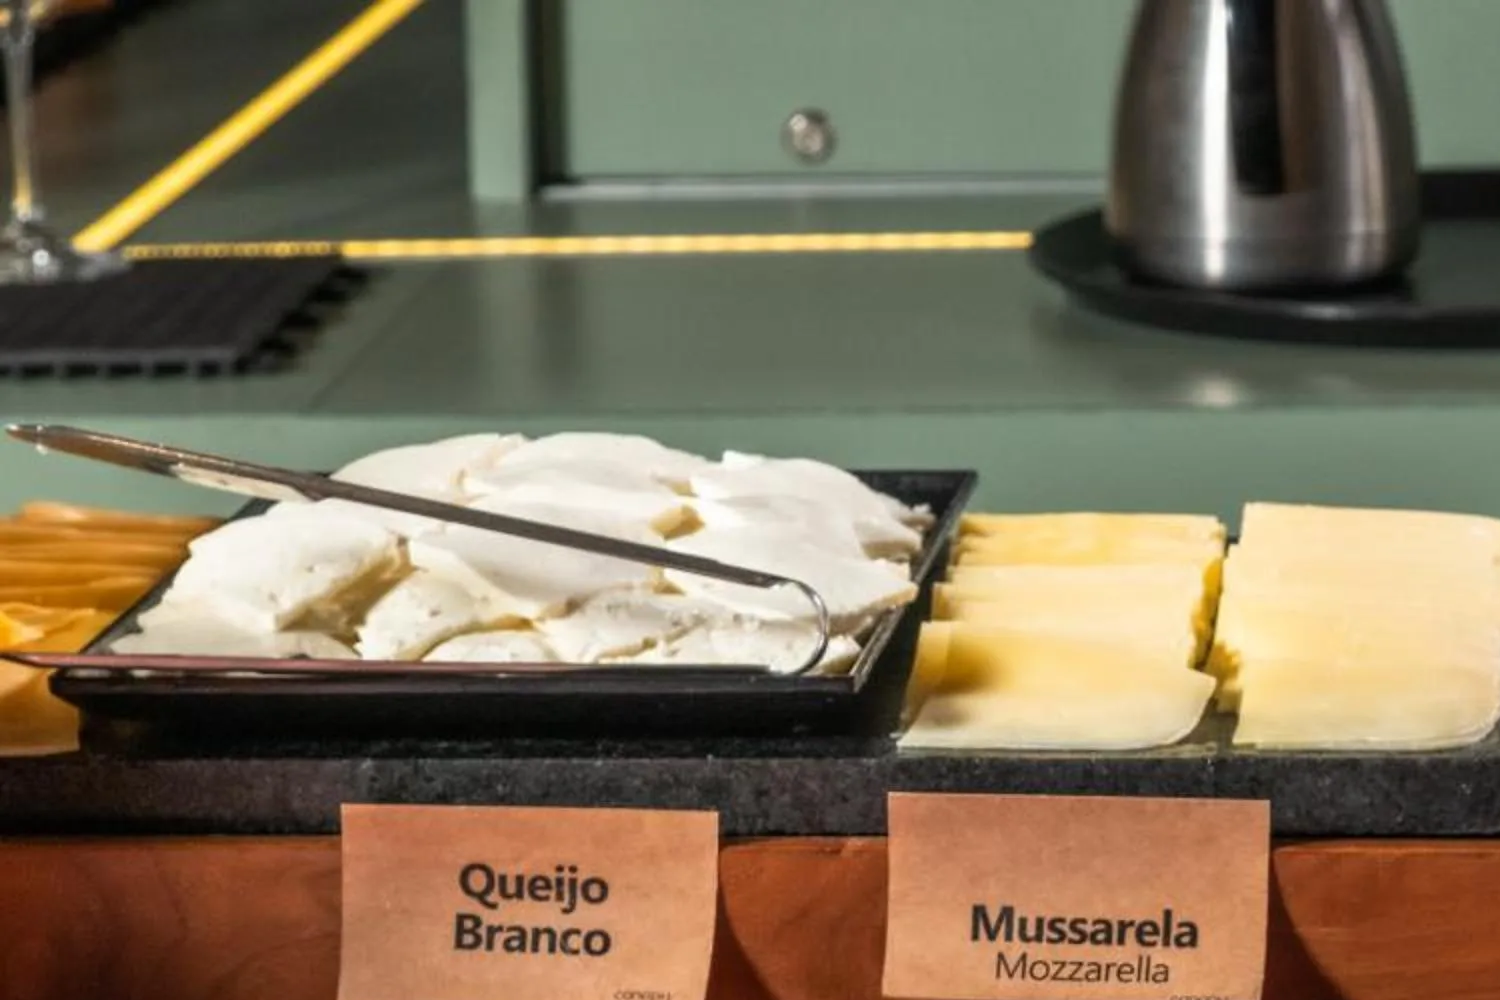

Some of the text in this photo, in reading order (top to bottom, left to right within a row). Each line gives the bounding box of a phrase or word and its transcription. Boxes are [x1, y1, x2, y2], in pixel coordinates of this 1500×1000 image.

[458, 863, 609, 915] Queijo
[454, 912, 612, 957] Branco
[971, 904, 1198, 949] Mussarela
[995, 951, 1169, 984] Mozzarella
